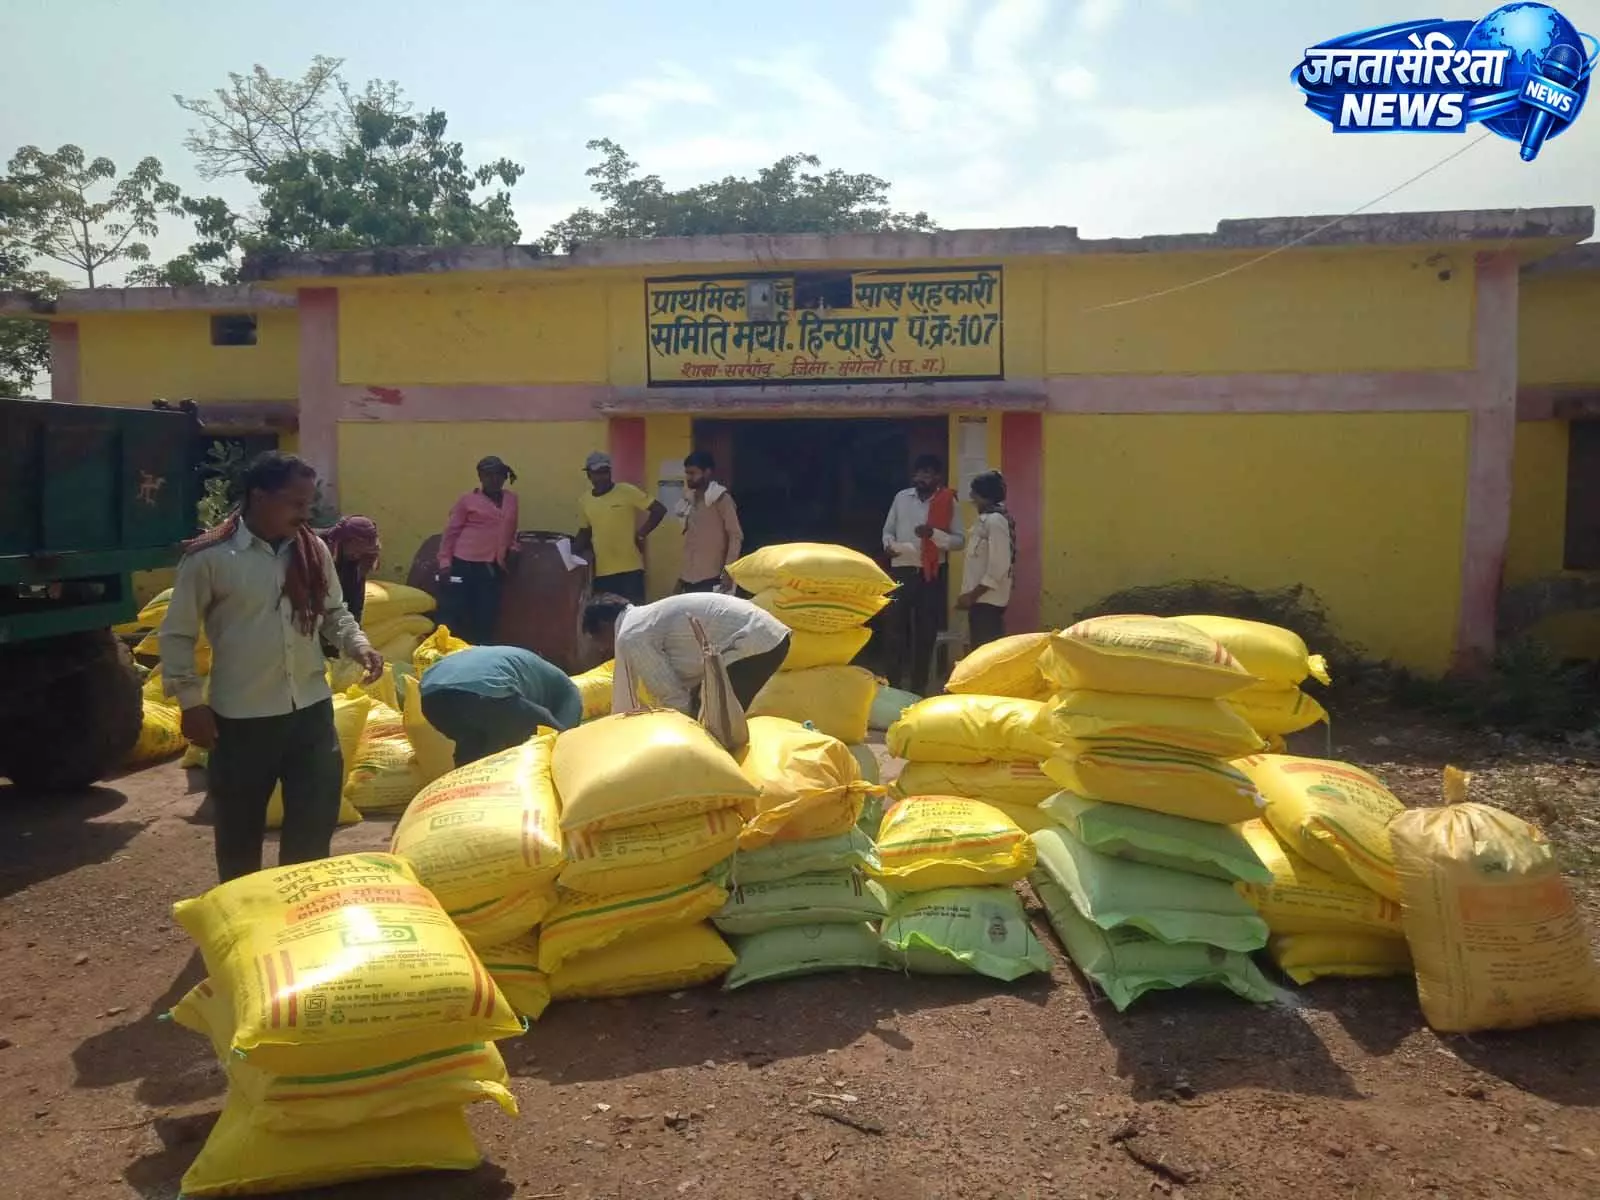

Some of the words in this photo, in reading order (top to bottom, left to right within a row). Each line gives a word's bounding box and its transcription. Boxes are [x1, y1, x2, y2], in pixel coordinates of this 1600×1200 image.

[651, 282, 746, 316] प्राथमिक
[906, 273, 998, 312] सहकारी
[651, 315, 730, 360] समिति
